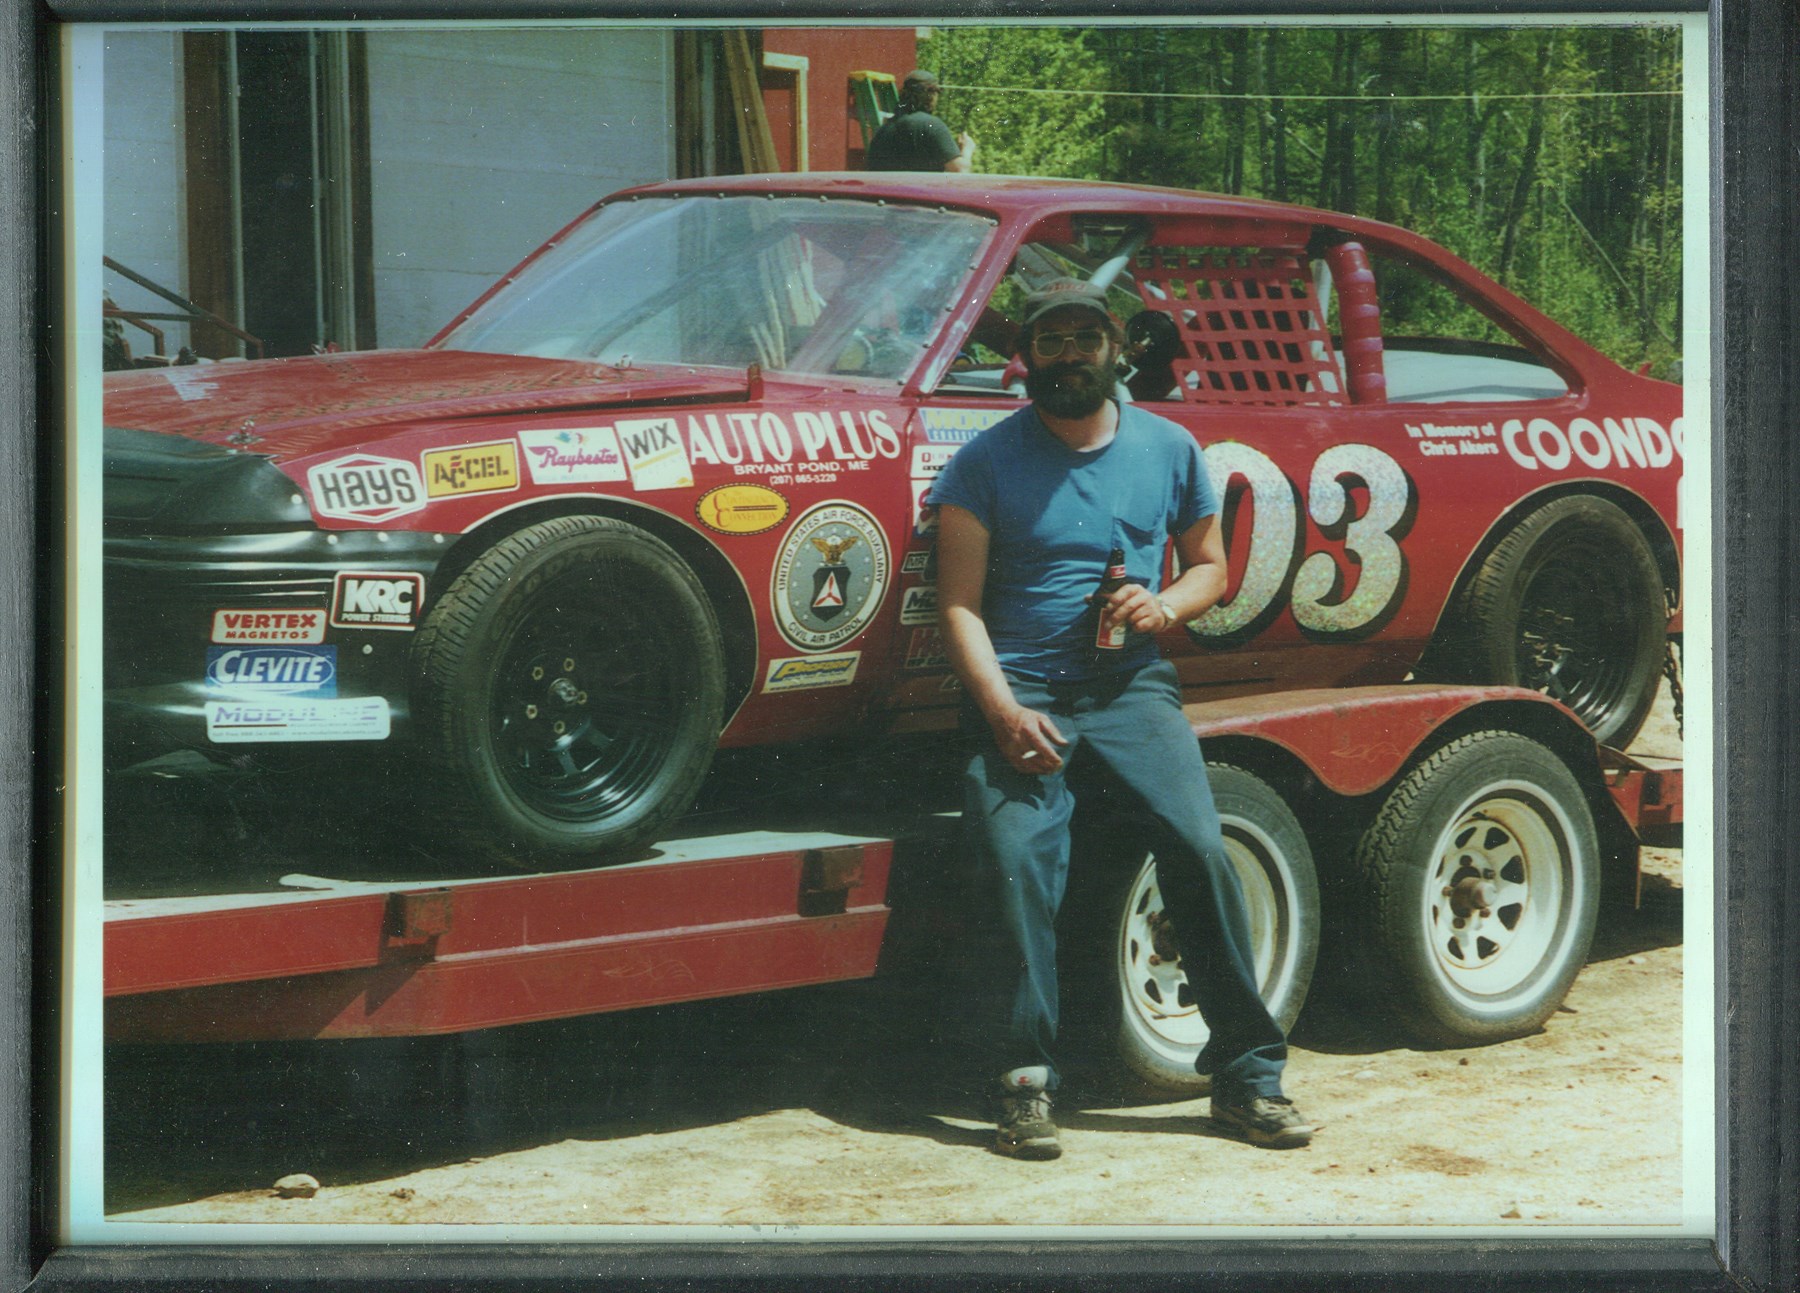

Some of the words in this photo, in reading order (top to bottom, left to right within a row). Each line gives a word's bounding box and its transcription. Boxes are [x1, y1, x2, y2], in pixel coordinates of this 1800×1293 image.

[623, 422, 676, 459] WIX
[688, 412, 794, 465] AUTO
[792, 409, 900, 460] PLUS
[1404, 423, 1423, 438] In
[1421, 423, 1480, 439] Memory
[1480, 422, 1496, 436] of
[528, 446, 618, 473] Raybestos
[1419, 440, 1458, 456] Chris
[1459, 440, 1499, 455] Akers
[434, 455, 509, 488] ACCEL
[733, 463, 794, 476] BRYANT
[798, 462, 845, 474] POND,
[848, 460, 870, 471] ME
[769, 475, 794, 486] (207)
[317, 467, 417, 509] Hays
[778, 549, 794, 591] UNITED
[791, 515, 821, 546] STATES
[822, 510, 838, 520] AIR
[840, 510, 867, 531] FORCE
[866, 529, 885, 584] AUXILIARY
[1172, 441, 1410, 637] 03
[343, 580, 415, 614] KRC
[223, 613, 317, 628] VERTEX
[341, 613, 371, 623] POWER
[372, 614, 411, 623] STEERING
[788, 621, 807, 643] CIVIL
[809, 633, 826, 643] AIR
[828, 617, 863, 642] PATROL
[225, 631, 309, 639] MAGNETOS
[215, 650, 326, 683] CLEVITE
